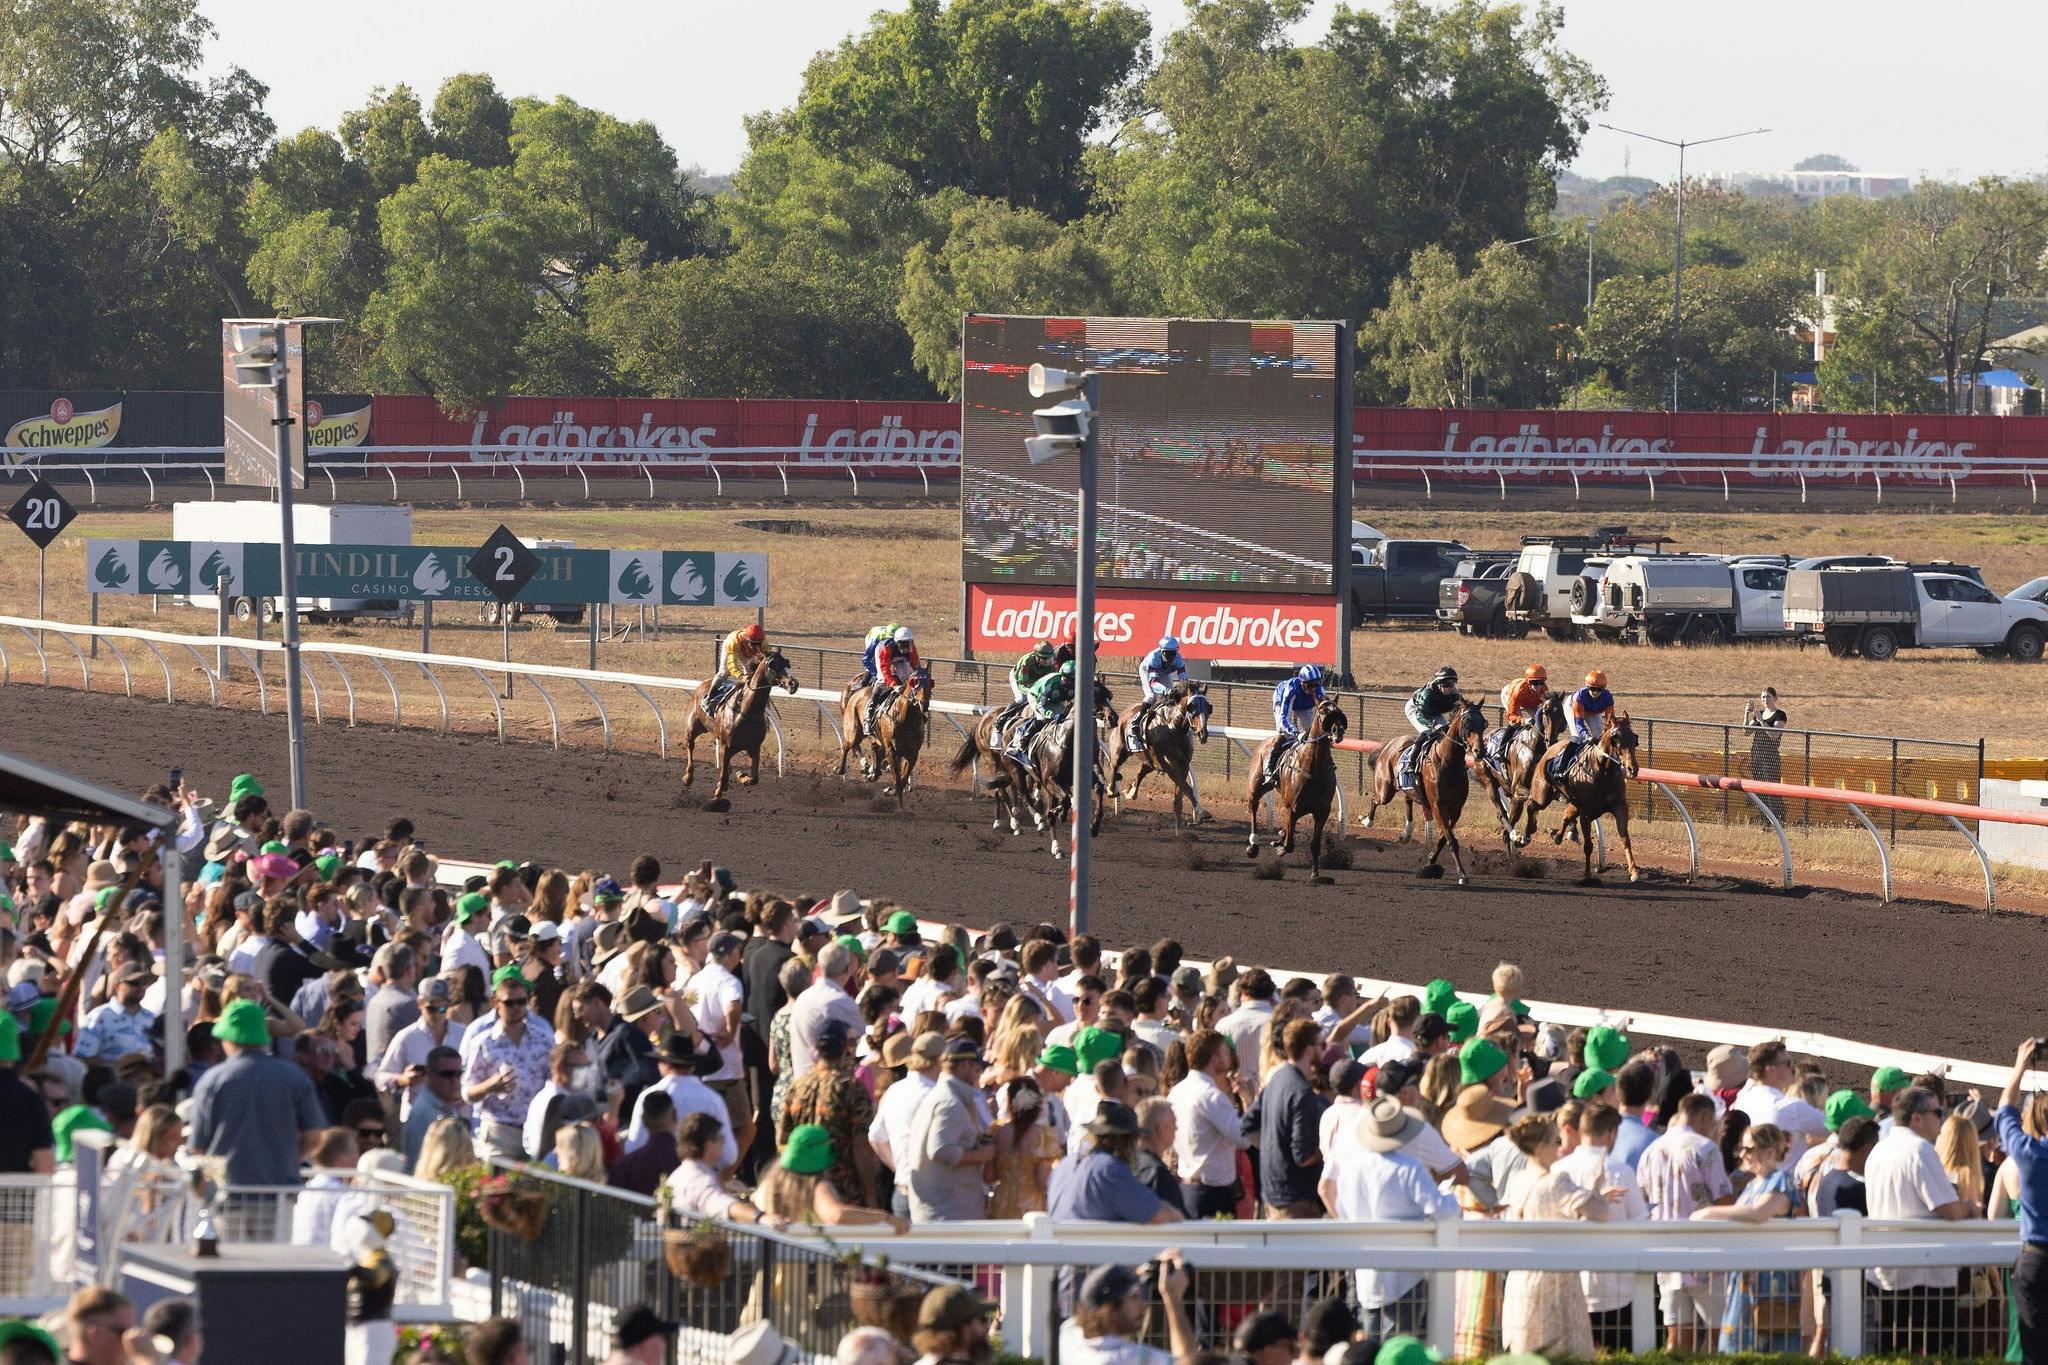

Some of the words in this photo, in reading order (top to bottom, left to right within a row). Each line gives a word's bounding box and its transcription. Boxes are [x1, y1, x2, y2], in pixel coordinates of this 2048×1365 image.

[17, 418, 109, 455] Schweppes
[469, 411, 716, 463] Ladbrokes
[1441, 423, 1675, 476] Ladbrokes
[1748, 427, 1977, 479] Ladbrokes
[26, 498, 60, 529] 20
[494, 546, 515, 581] 2
[351, 583, 409, 595] CASINO
[981, 598, 1135, 643] Ladbroes
[1164, 605, 1323, 649] Ladbrokes
